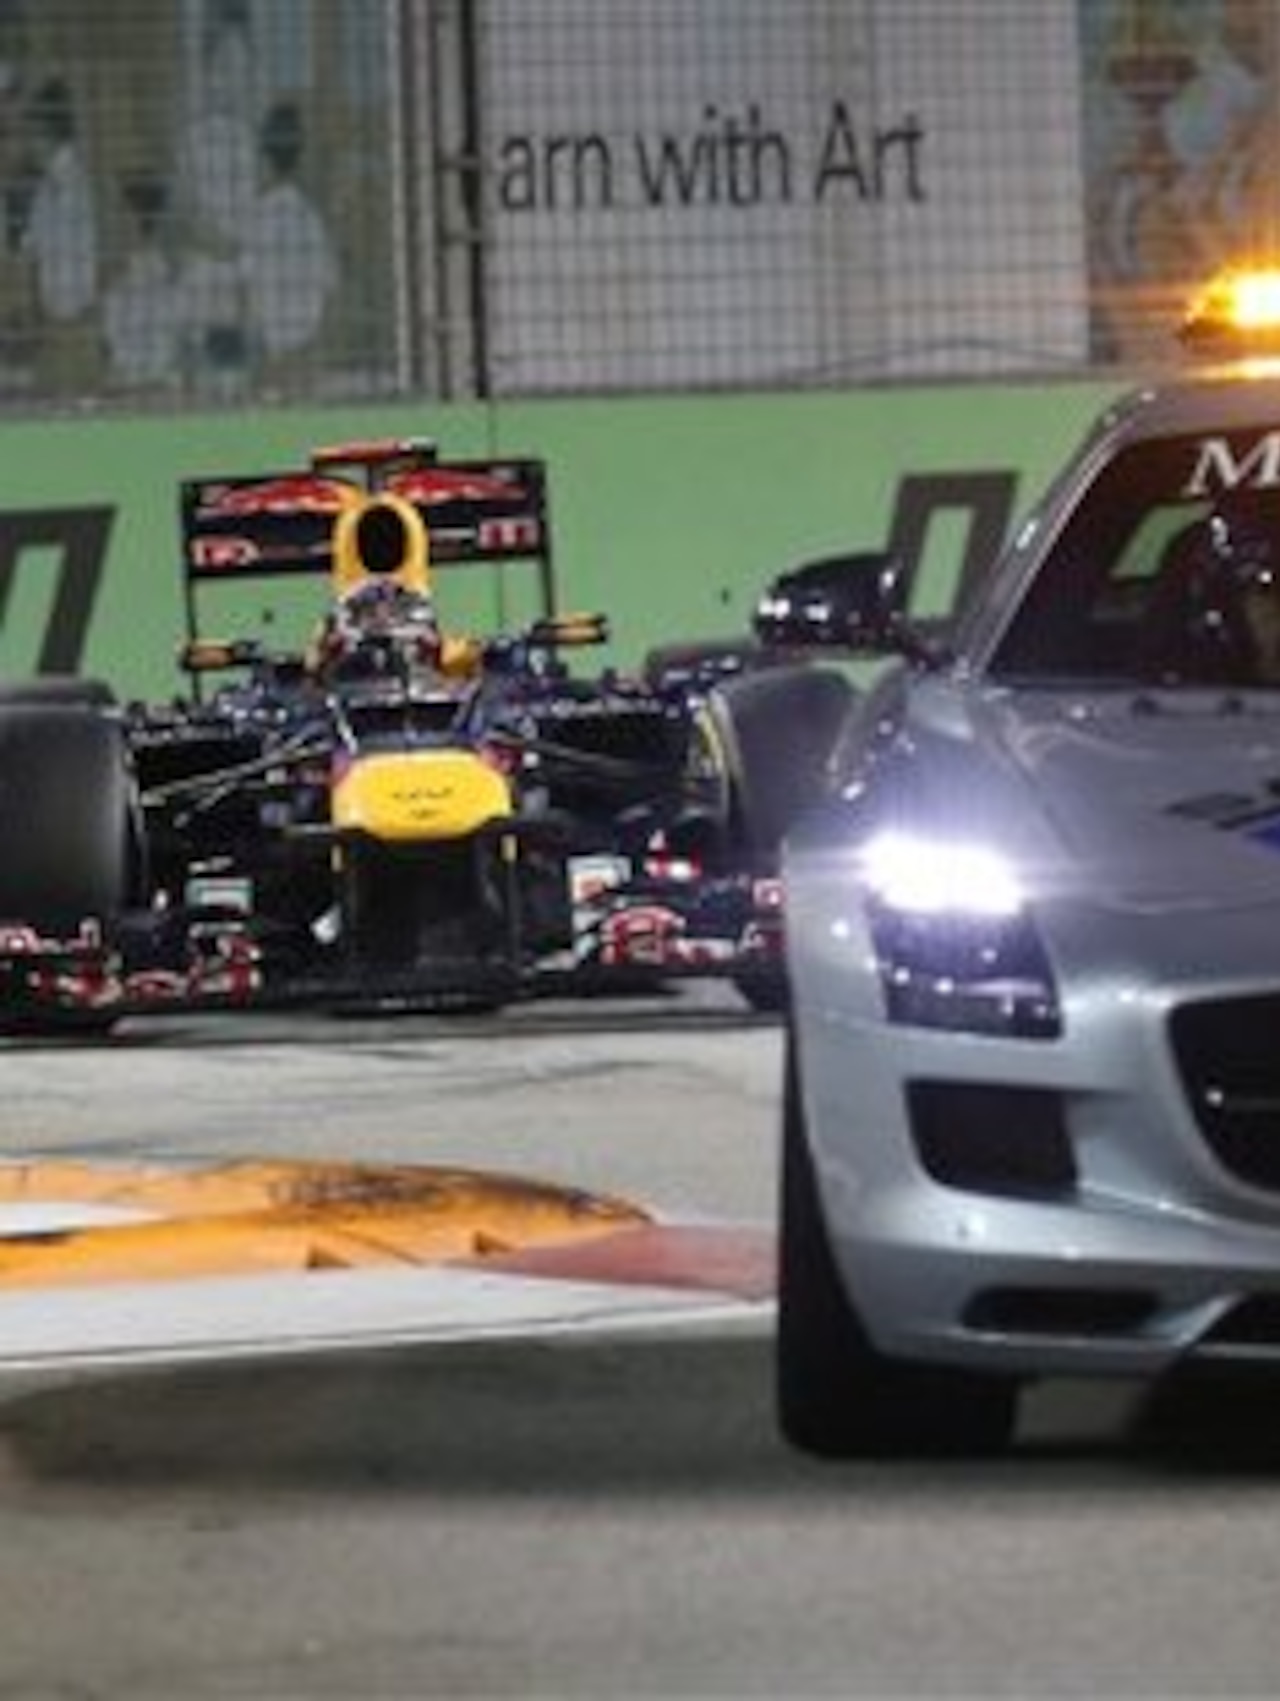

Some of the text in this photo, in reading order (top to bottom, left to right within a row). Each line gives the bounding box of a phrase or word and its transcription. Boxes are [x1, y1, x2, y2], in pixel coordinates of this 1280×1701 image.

[499, 100, 926, 210] arn with Art
